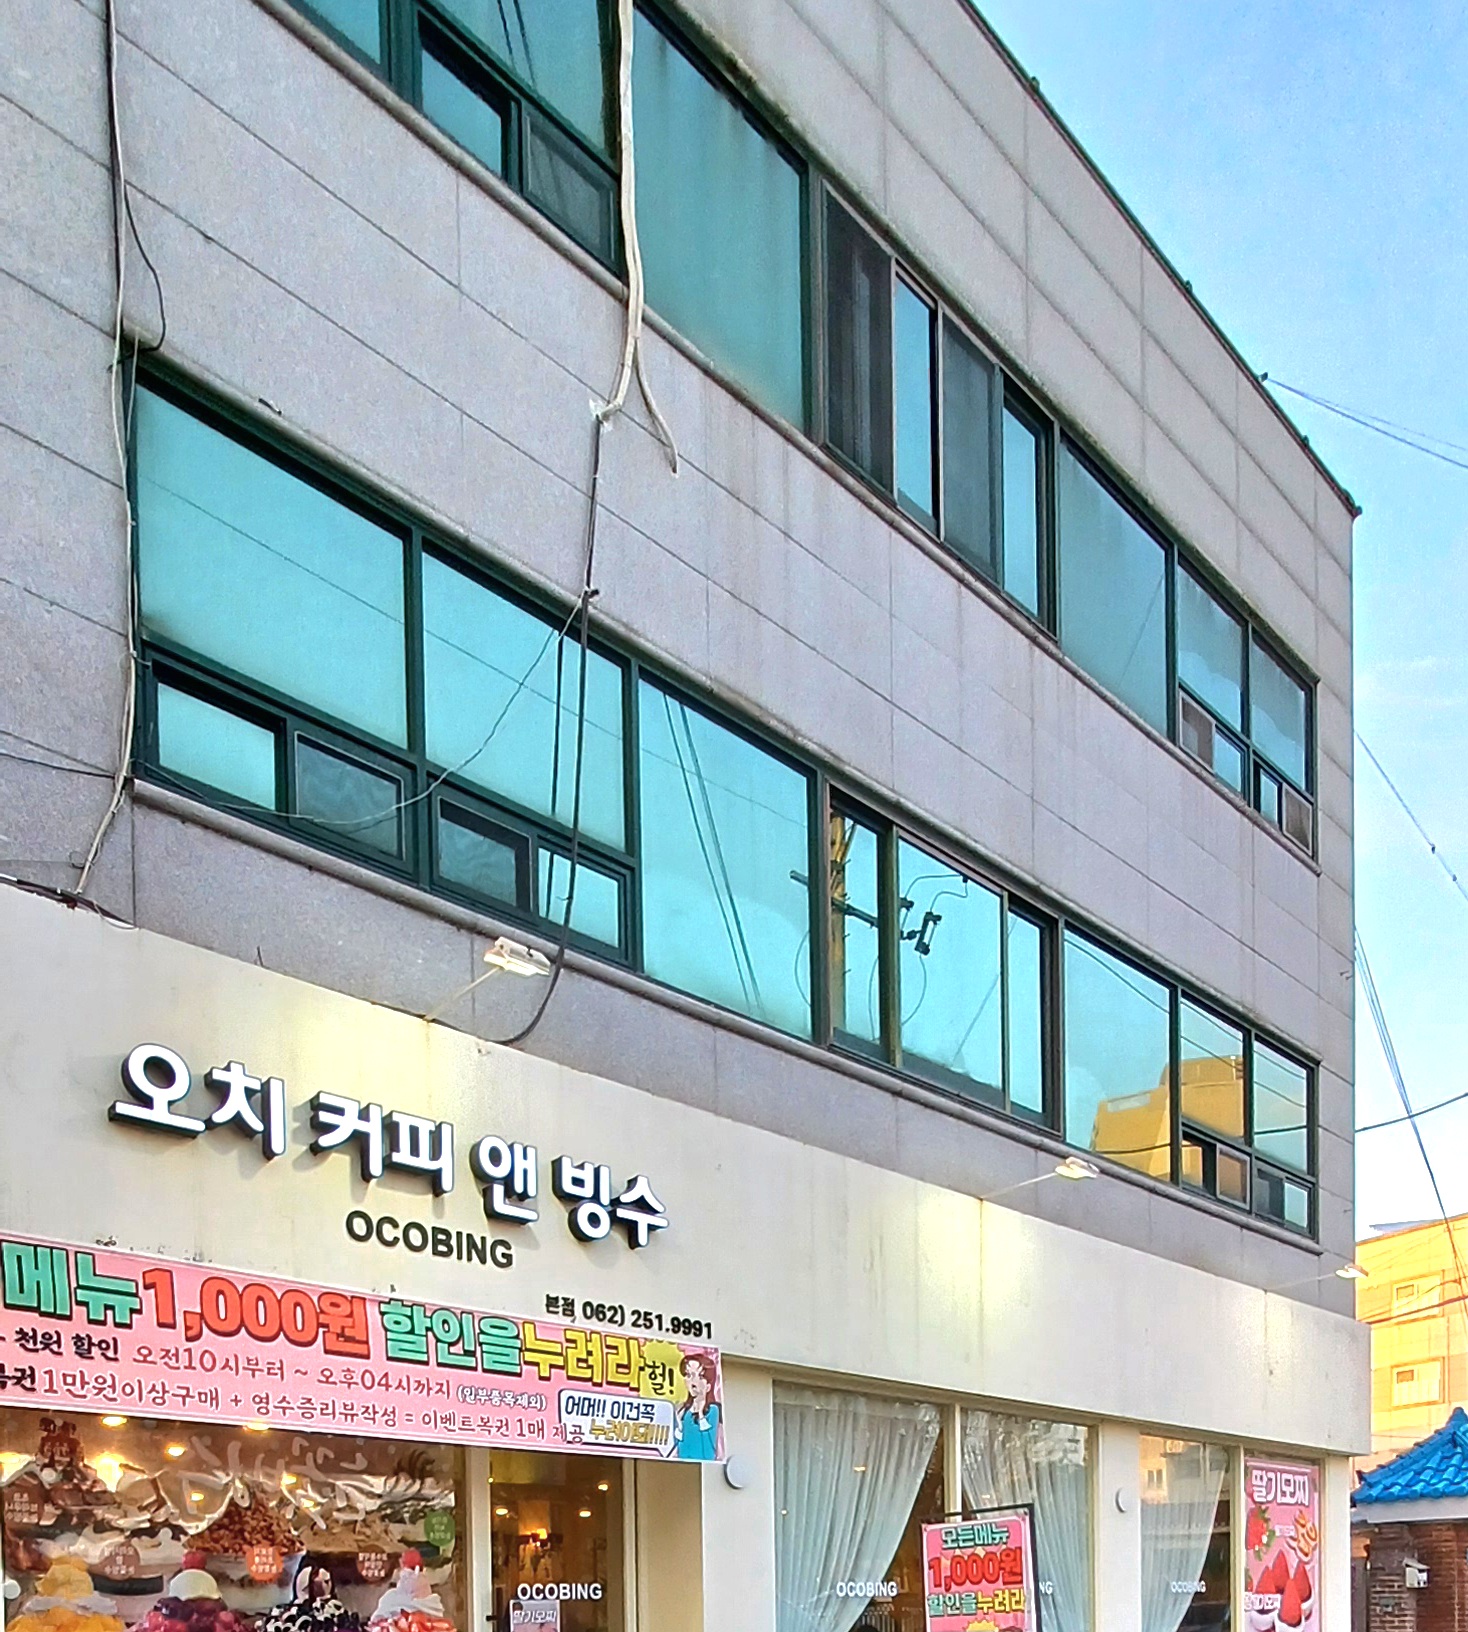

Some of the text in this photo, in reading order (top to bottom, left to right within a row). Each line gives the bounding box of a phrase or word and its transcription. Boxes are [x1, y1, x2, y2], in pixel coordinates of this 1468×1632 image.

[109, 1043, 669, 1249] 오치 커피 앤 빙수
[346, 1210, 513, 1268] OCOBING
[582, 1301, 625, 1327] 062)
[631, 1310, 713, 1339] 251.9991
[15, 1327, 63, 1355] 천원
[71, 1333, 119, 1361] 할인
[133, 1345, 284, 1382] 오전10시부터
[317, 1367, 450, 1399] 오후04시까지
[565, 1395, 606, 1418] 어머!!
[422, 1409, 510, 1438] 이벤트복권
[552, 1422, 585, 1444] 제공
[1252, 1469, 1309, 1506] 딸기모찌
[941, 1522, 1010, 1549] 모든메뉴
[928, 1547, 1023, 1592] 1,000원
[517, 1583, 603, 1600] OCOBING
[836, 1581, 897, 1597] OCOBING
